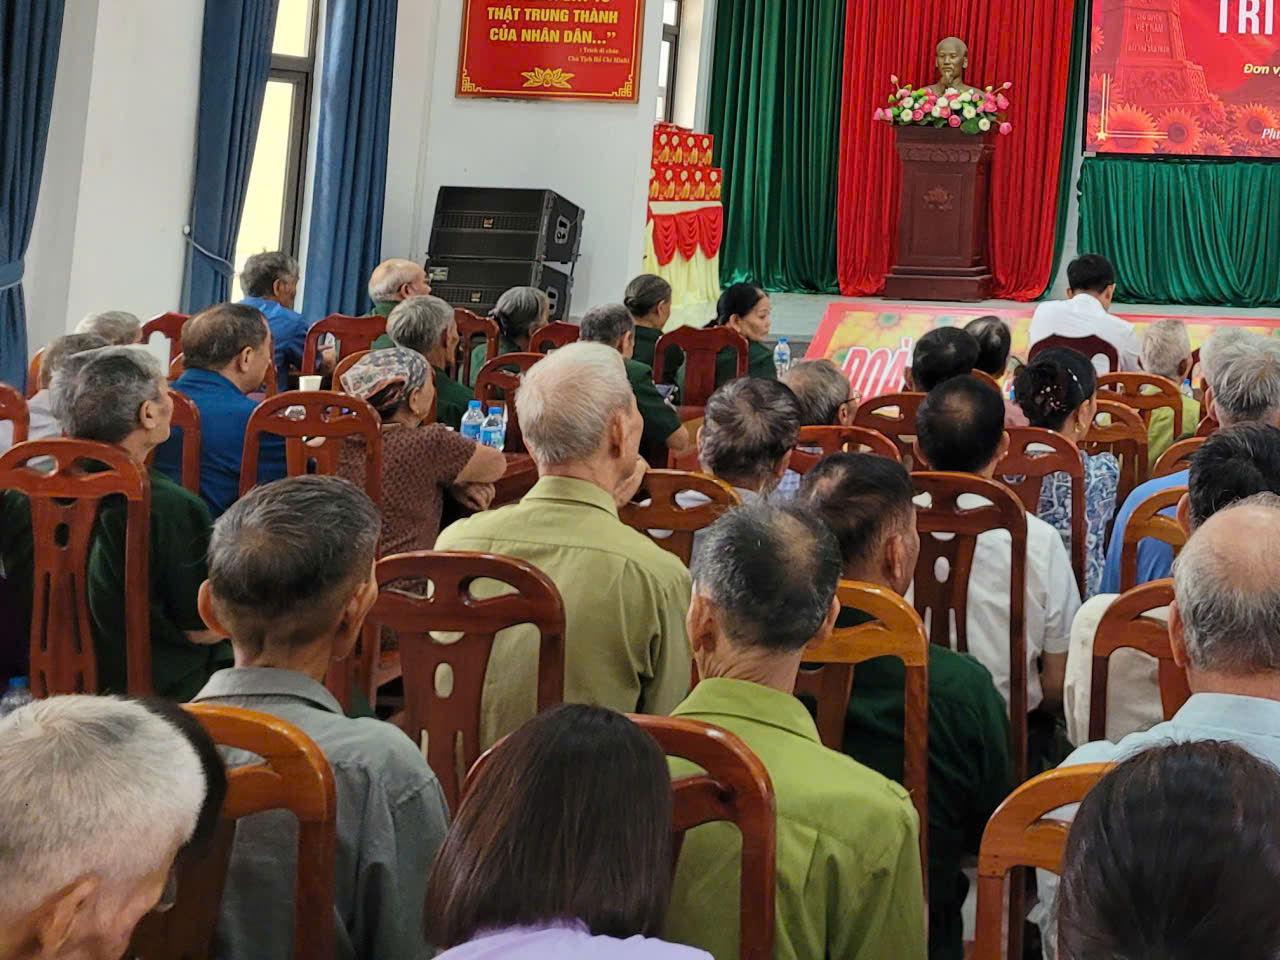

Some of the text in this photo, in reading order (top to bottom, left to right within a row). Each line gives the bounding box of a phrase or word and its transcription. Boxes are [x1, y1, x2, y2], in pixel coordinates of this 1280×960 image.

[488, 6, 521, 23] THẬT
[524, 9, 569, 22] TRUNG
[522, 28, 560, 43] NHÂN
[1243, 63, 1269, 74] Đơn
